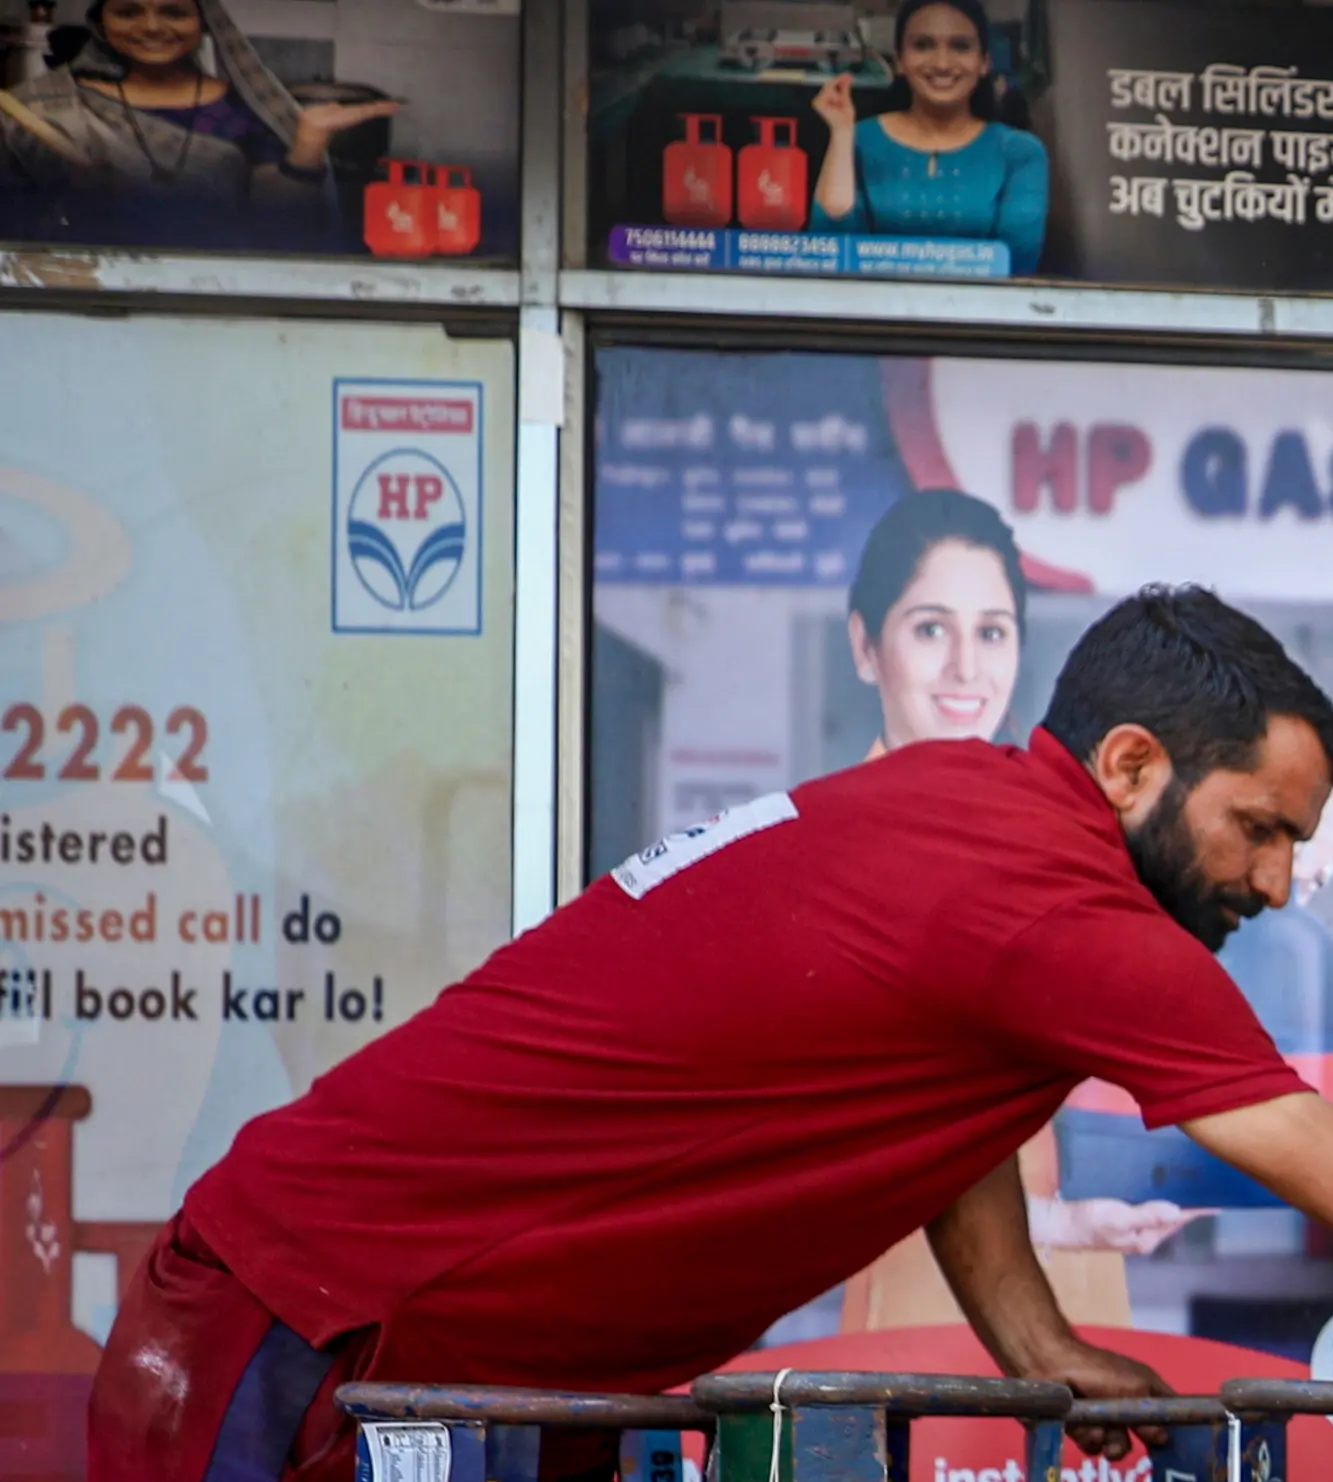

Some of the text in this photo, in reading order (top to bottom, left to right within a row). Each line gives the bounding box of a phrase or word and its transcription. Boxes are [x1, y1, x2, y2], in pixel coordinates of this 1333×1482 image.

[1107, 68, 1194, 111] डबल
[1107, 114, 1266, 168] कनेक्शन
[1108, 176, 1169, 217] अब
[1172, 171, 1311, 231] चुटकियों
[1008, 418, 1153, 516] HP
[376, 472, 443, 519] HP
[1, 702, 211, 783] 2222
[0, 814, 169, 865] istered
[177, 892, 261, 944] call
[282, 892, 342, 944] do
[74, 968, 199, 1021] book
[222, 970, 305, 1021] kar
[324, 970, 385, 1023] lo!
